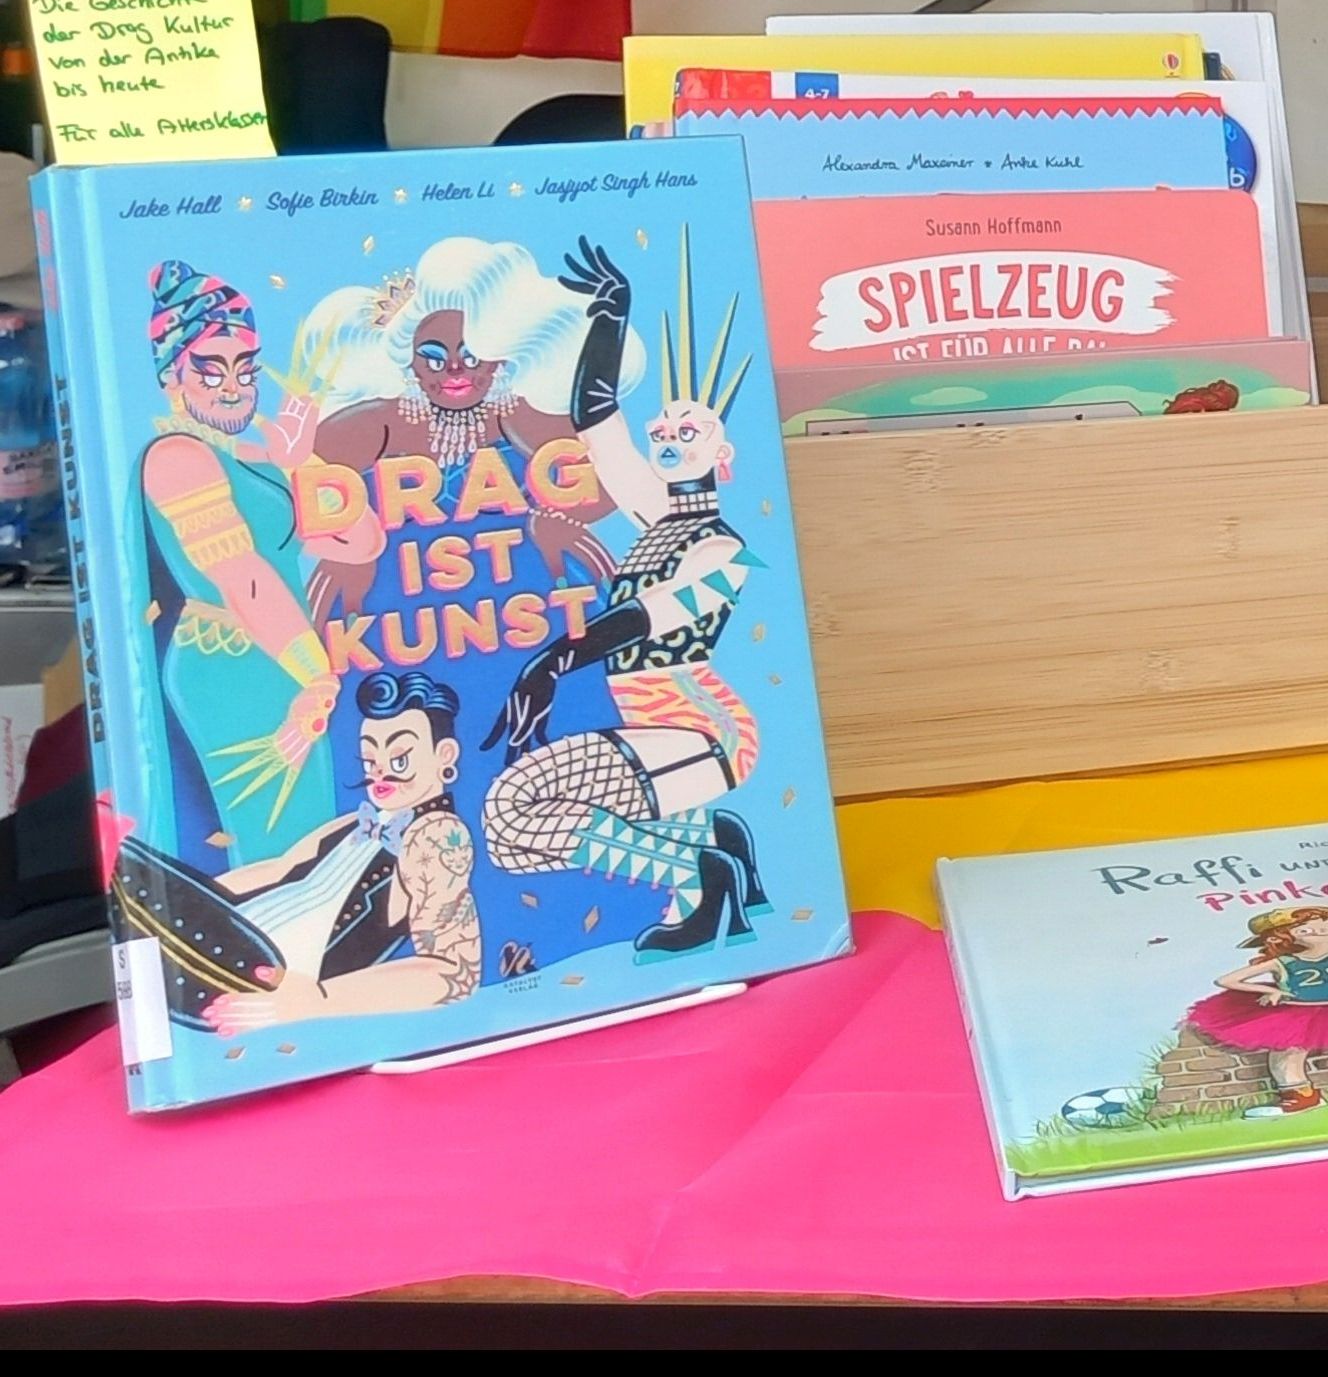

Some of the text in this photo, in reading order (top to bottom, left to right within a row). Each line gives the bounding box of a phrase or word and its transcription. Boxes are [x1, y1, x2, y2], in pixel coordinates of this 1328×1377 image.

[43, 14, 234, 44] der Drag Kultur
[49, 41, 220, 70] von der Antike
[54, 75, 165, 97] bis heute
[56, 121, 145, 142] Für alle
[822, 154, 899, 171] Alexandra
[1001, 155, 1038, 170] Anke
[1045, 155, 1083, 170] Kuhl
[119, 198, 170, 220] Jake
[176, 195, 223, 216] Hall
[265, 188, 315, 214] Sofie
[320, 186, 379, 208] Birkin
[422, 182, 474, 201] Helen
[477, 182, 496, 200] Li
[601, 174, 650, 199] Singh
[656, 171, 699, 190] Hans
[926, 217, 1062, 237] Susann Hoffmann
[858, 263, 1126, 334] SPIELZEUG
[291, 438, 601, 539] DRAG
[399, 528, 524, 595] IST
[325, 585, 598, 675] KUNST
[1091, 855, 1263, 895] Raffi
